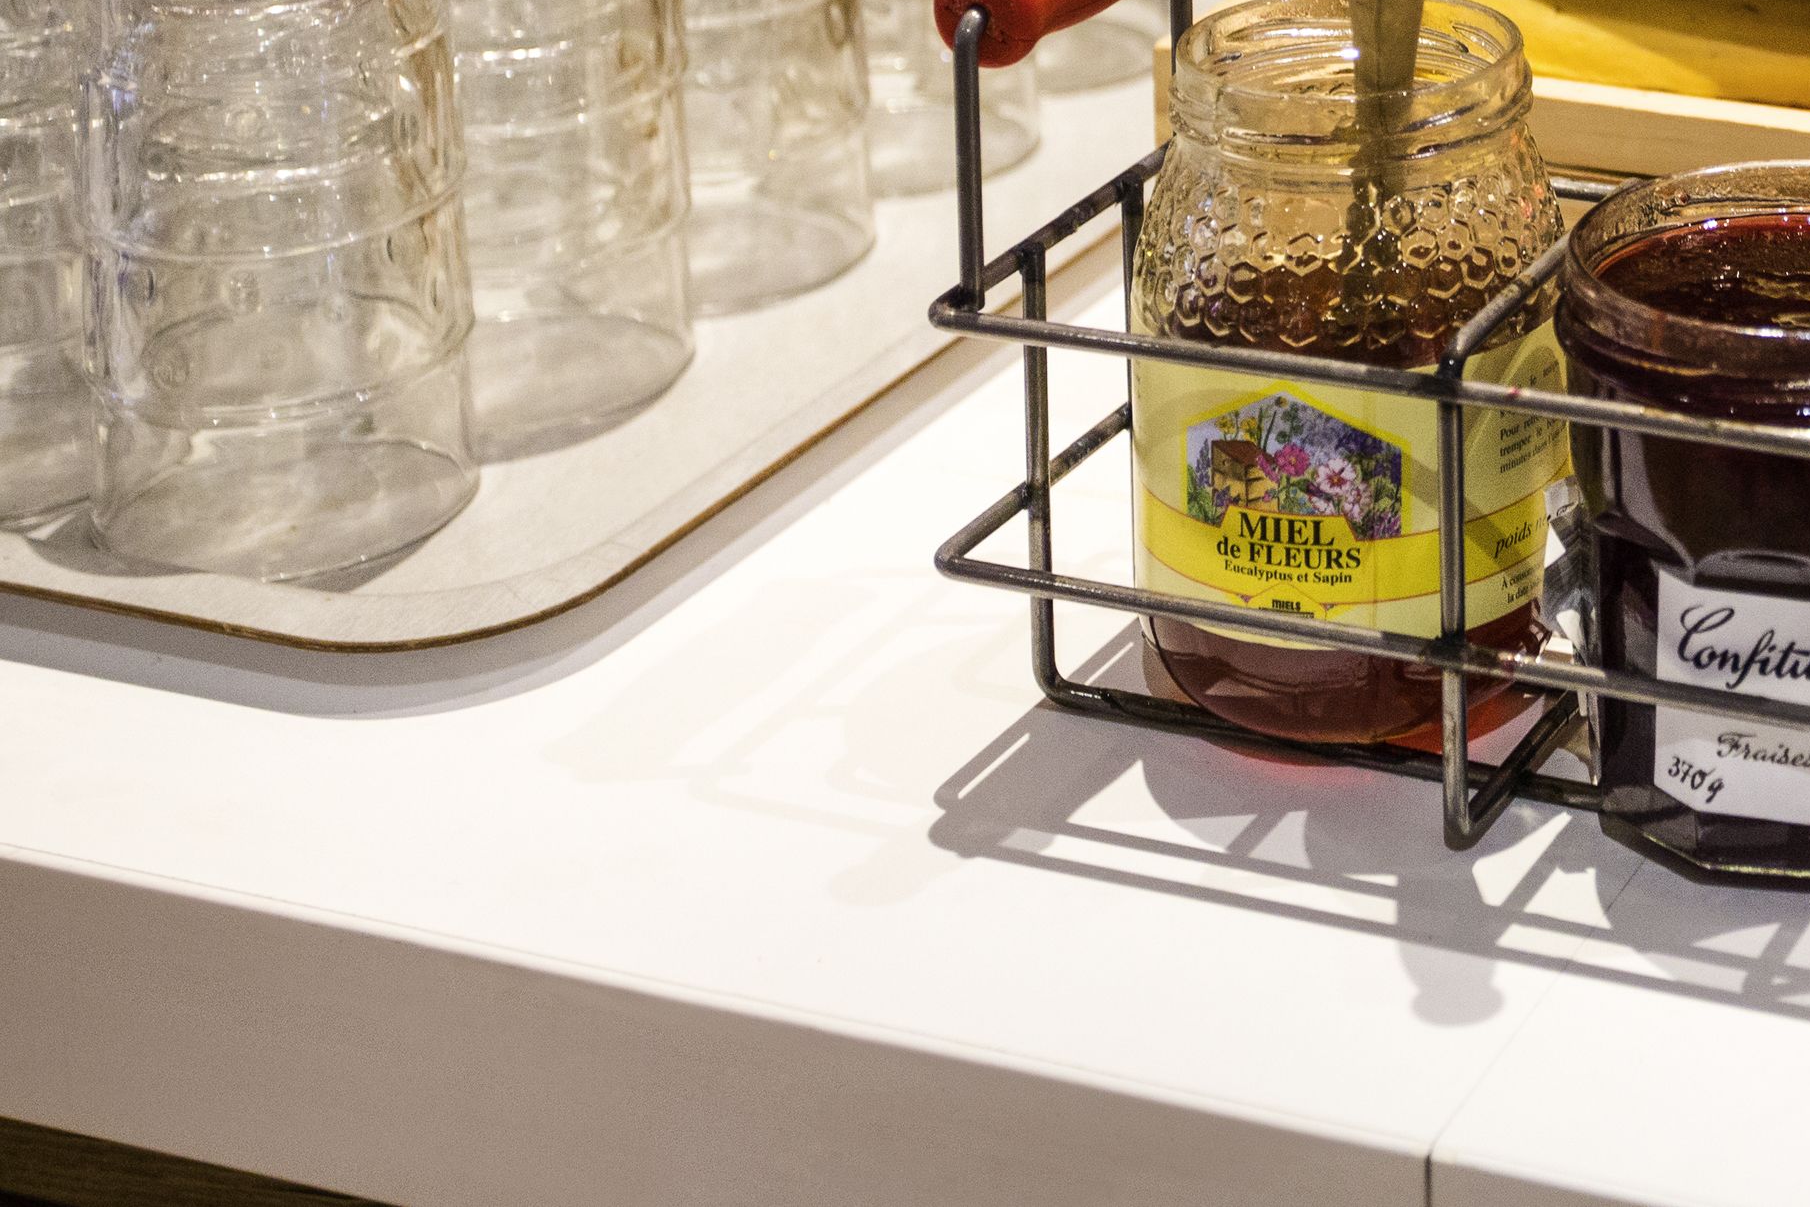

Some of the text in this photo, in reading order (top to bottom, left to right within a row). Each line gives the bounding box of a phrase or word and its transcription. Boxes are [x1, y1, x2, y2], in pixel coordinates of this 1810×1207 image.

[1238, 511, 1335, 547] MIEL
[1494, 521, 1532, 559] poids
[1216, 535, 1361, 570] de FLEURS
[1224, 559, 1352, 586] Eucalyptus et Sapin
[1271, 599, 1301, 612] MIELS
